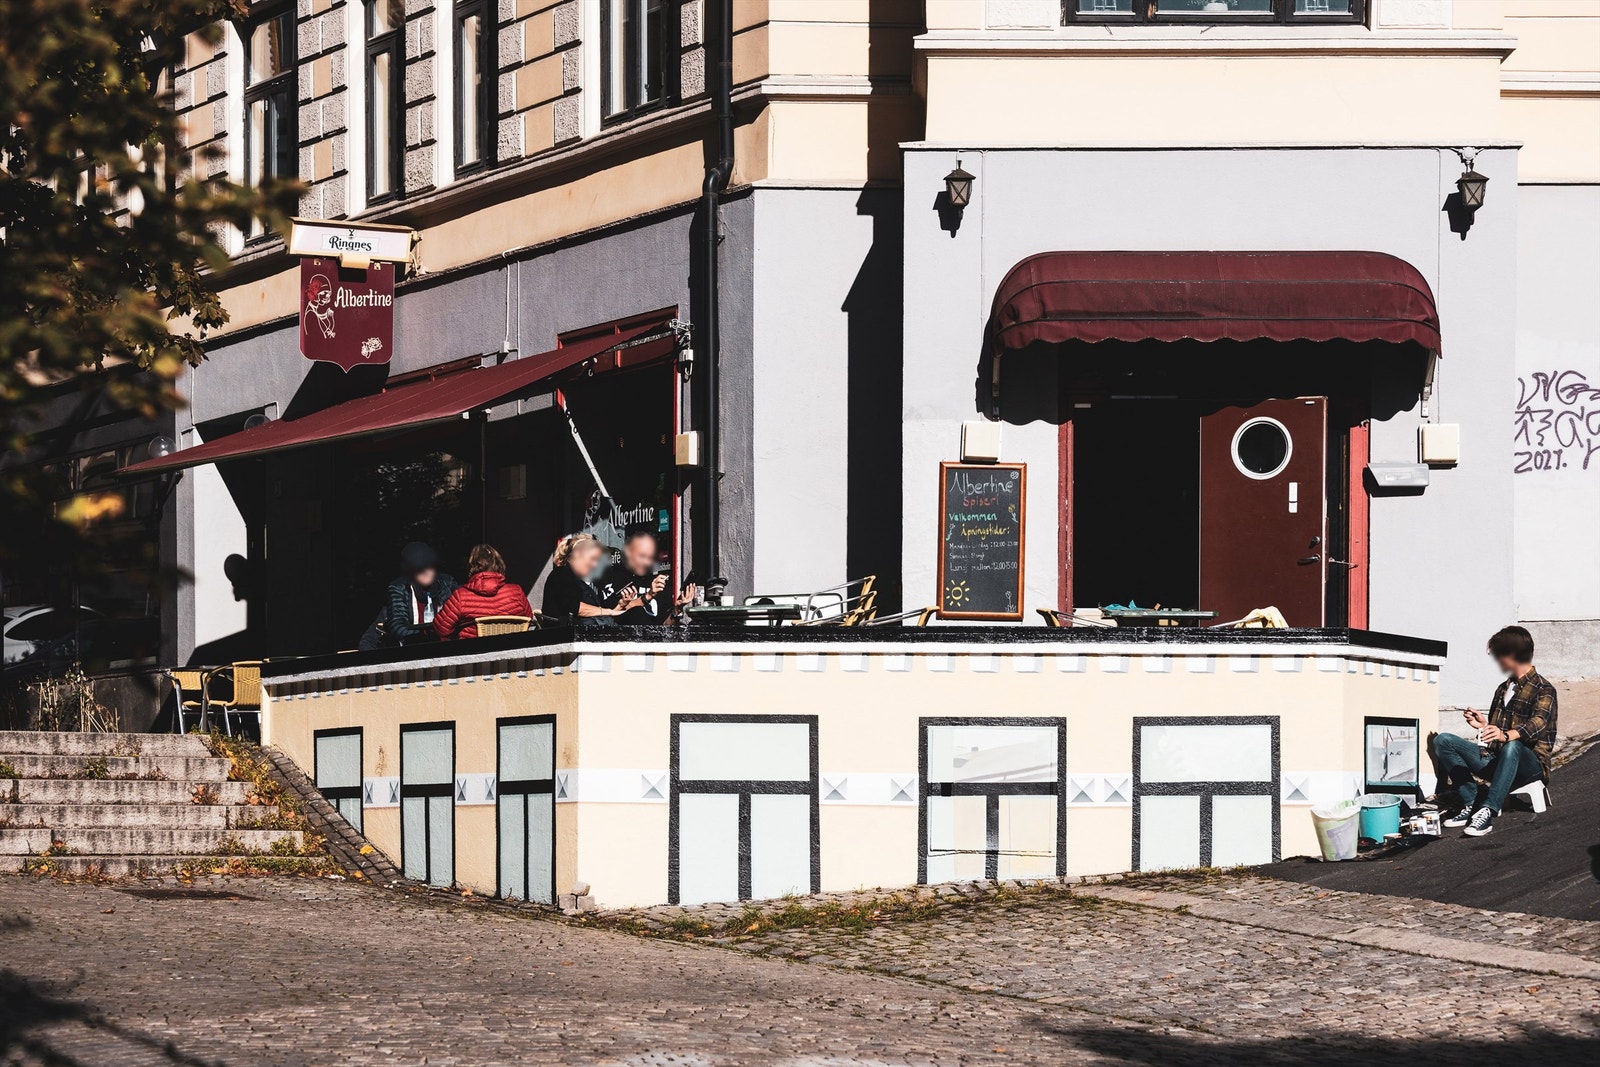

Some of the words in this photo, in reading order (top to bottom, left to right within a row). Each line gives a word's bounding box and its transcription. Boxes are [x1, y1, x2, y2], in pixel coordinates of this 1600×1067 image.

[328, 235, 372, 252] Ringnes
[334, 286, 392, 308] Albertine
[949, 471, 1014, 496] Albertine
[604, 503, 654, 534] Albertine
[949, 512, 998, 522] Velkommen
